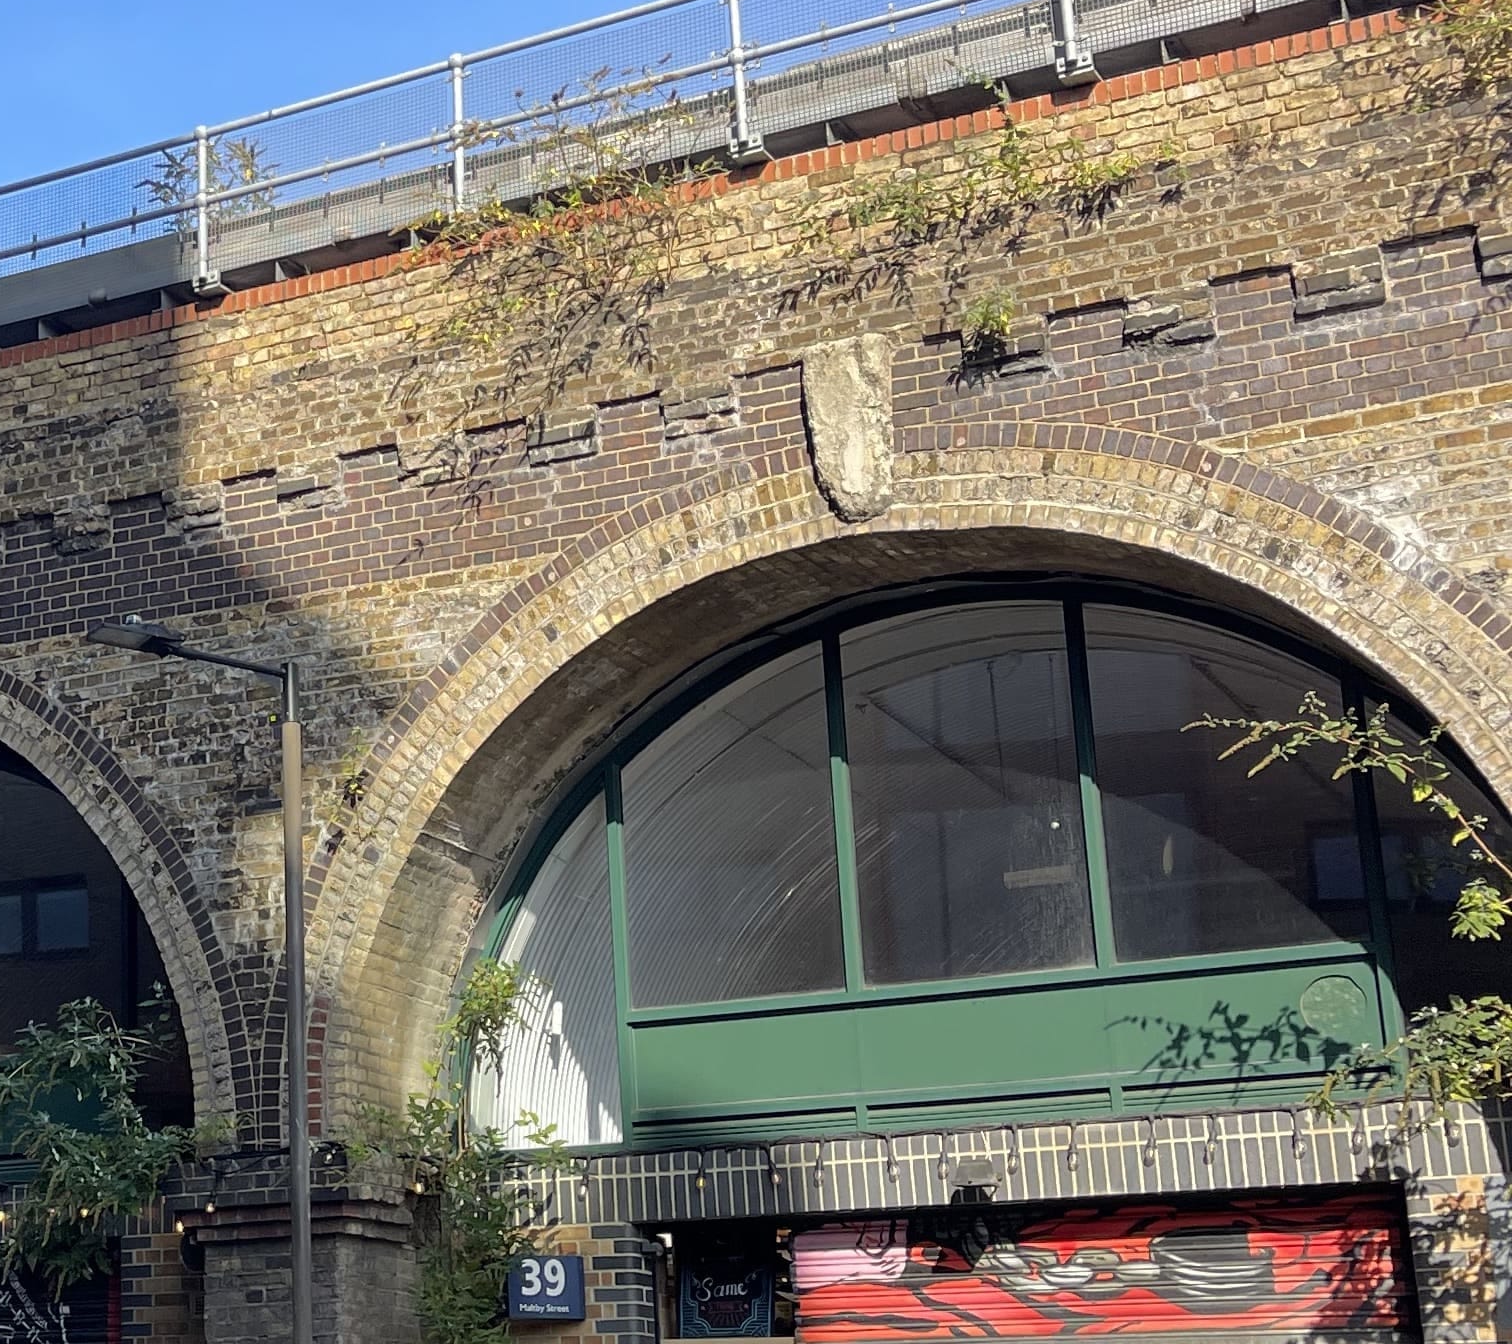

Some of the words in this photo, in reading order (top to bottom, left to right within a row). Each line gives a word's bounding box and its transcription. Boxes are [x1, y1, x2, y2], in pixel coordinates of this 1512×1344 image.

[520, 1258, 566, 1297] 39
[519, 1303, 545, 1314] Maltby
[546, 1303, 570, 1313] Street
